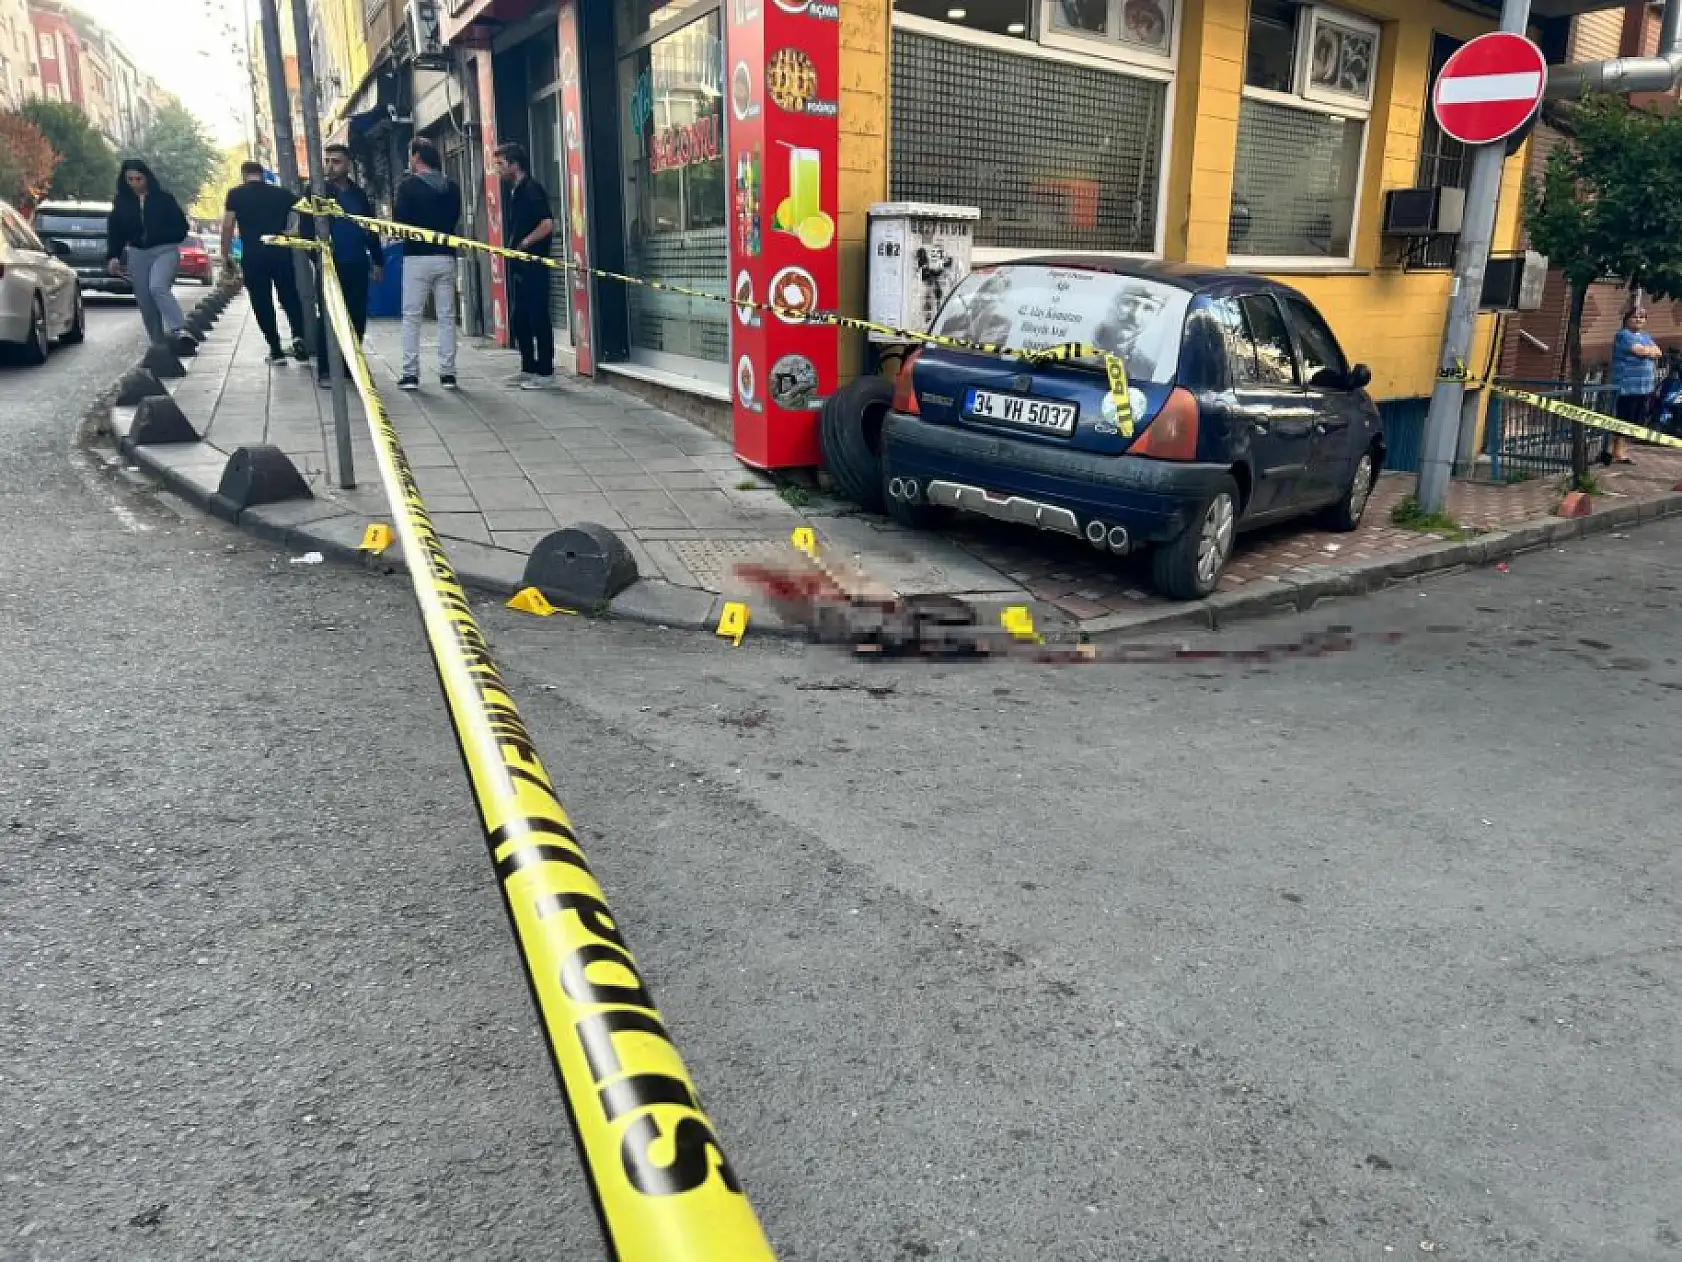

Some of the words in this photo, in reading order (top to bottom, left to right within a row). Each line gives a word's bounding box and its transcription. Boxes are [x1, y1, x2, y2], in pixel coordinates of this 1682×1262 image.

[975, 392, 993, 415] 34
[1003, 397, 1024, 419] VH
[1028, 402, 1073, 427] 5037
